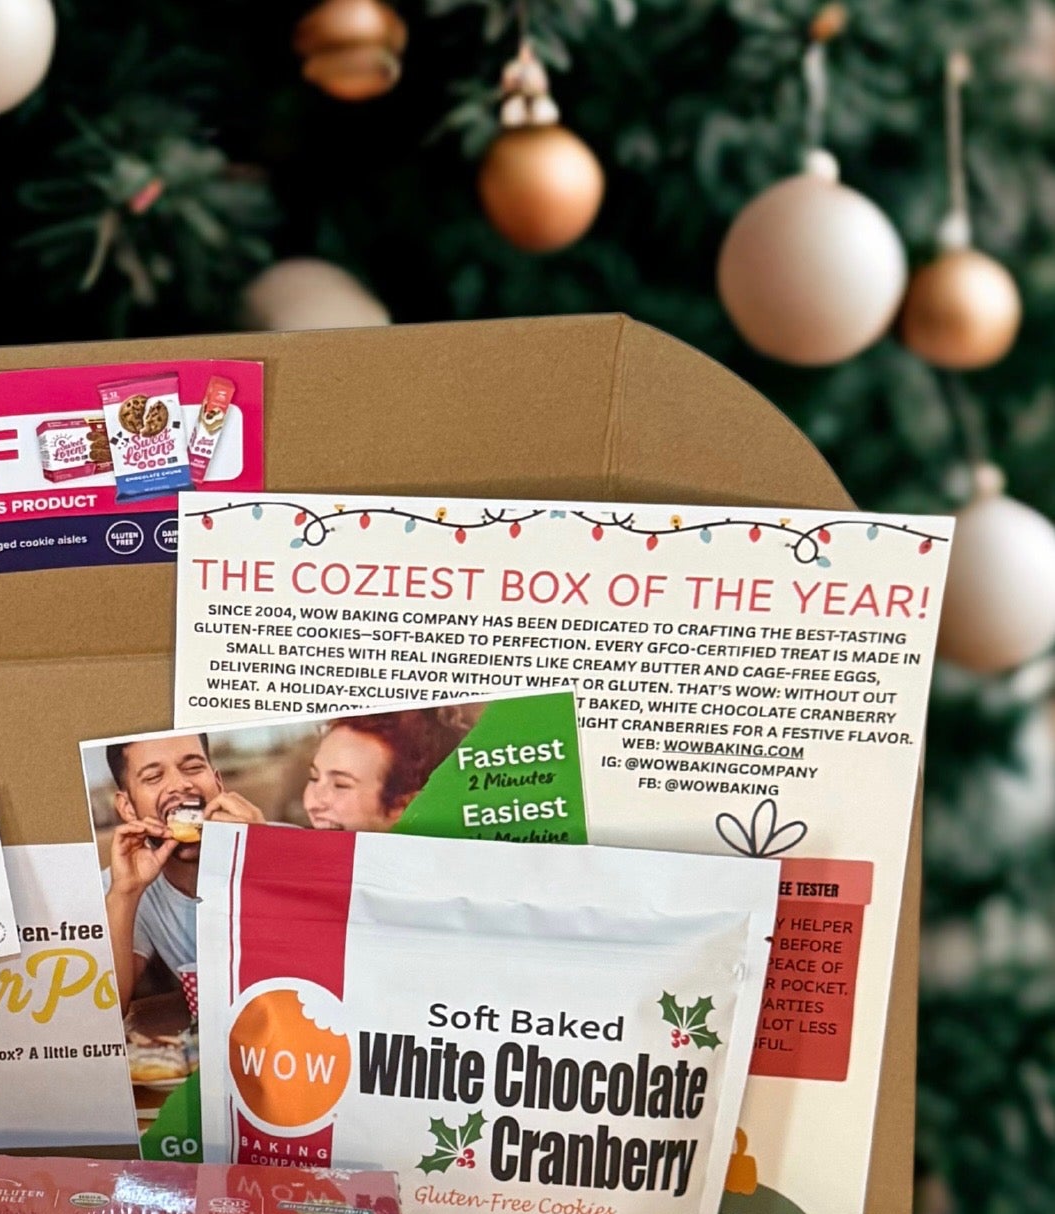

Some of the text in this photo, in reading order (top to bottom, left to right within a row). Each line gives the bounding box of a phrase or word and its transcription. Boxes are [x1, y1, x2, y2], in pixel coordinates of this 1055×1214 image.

[11, 494, 97, 512] PRODUCT
[19, 536, 55, 547] cookie
[57, 534, 87, 544] aisles
[111, 532, 139, 540] GLUTEN
[192, 558, 929, 619] THE COZIEST BOX OF THE YEAR!
[208, 604, 906, 644] SINCE 2004, WOW BAKING COMPANY HAS BEEN DEDICATED TO CRAFTING THE BEST-TASTING
[457, 738, 565, 770] Fastest
[622, 737, 804, 760] WEB: WOWBAKING.COM
[601, 755, 818, 778] IG: @WOWBAKINGCOMPANY
[468, 771, 556, 791] 2 Minutes
[638, 777, 778, 795] FB: @WOWBAKING
[463, 796, 568, 827] Easiest
[796, 881, 839, 898] TESTER
[790, 919, 853, 934] HELPER
[780, 938, 842, 954] BEFORE
[781, 979, 848, 996] POCKET.
[427, 1003, 625, 1042] Soft Baked
[29, 1047, 39, 1060] A
[44, 1045, 78, 1059] little
[240, 1045, 336, 1084] WOW
[359, 1030, 708, 1119] White Chocolate
[241, 1136, 328, 1160] BAKING
[490, 1116, 698, 1198] Cranberry
[414, 1186, 534, 1214] Gluten-Free
